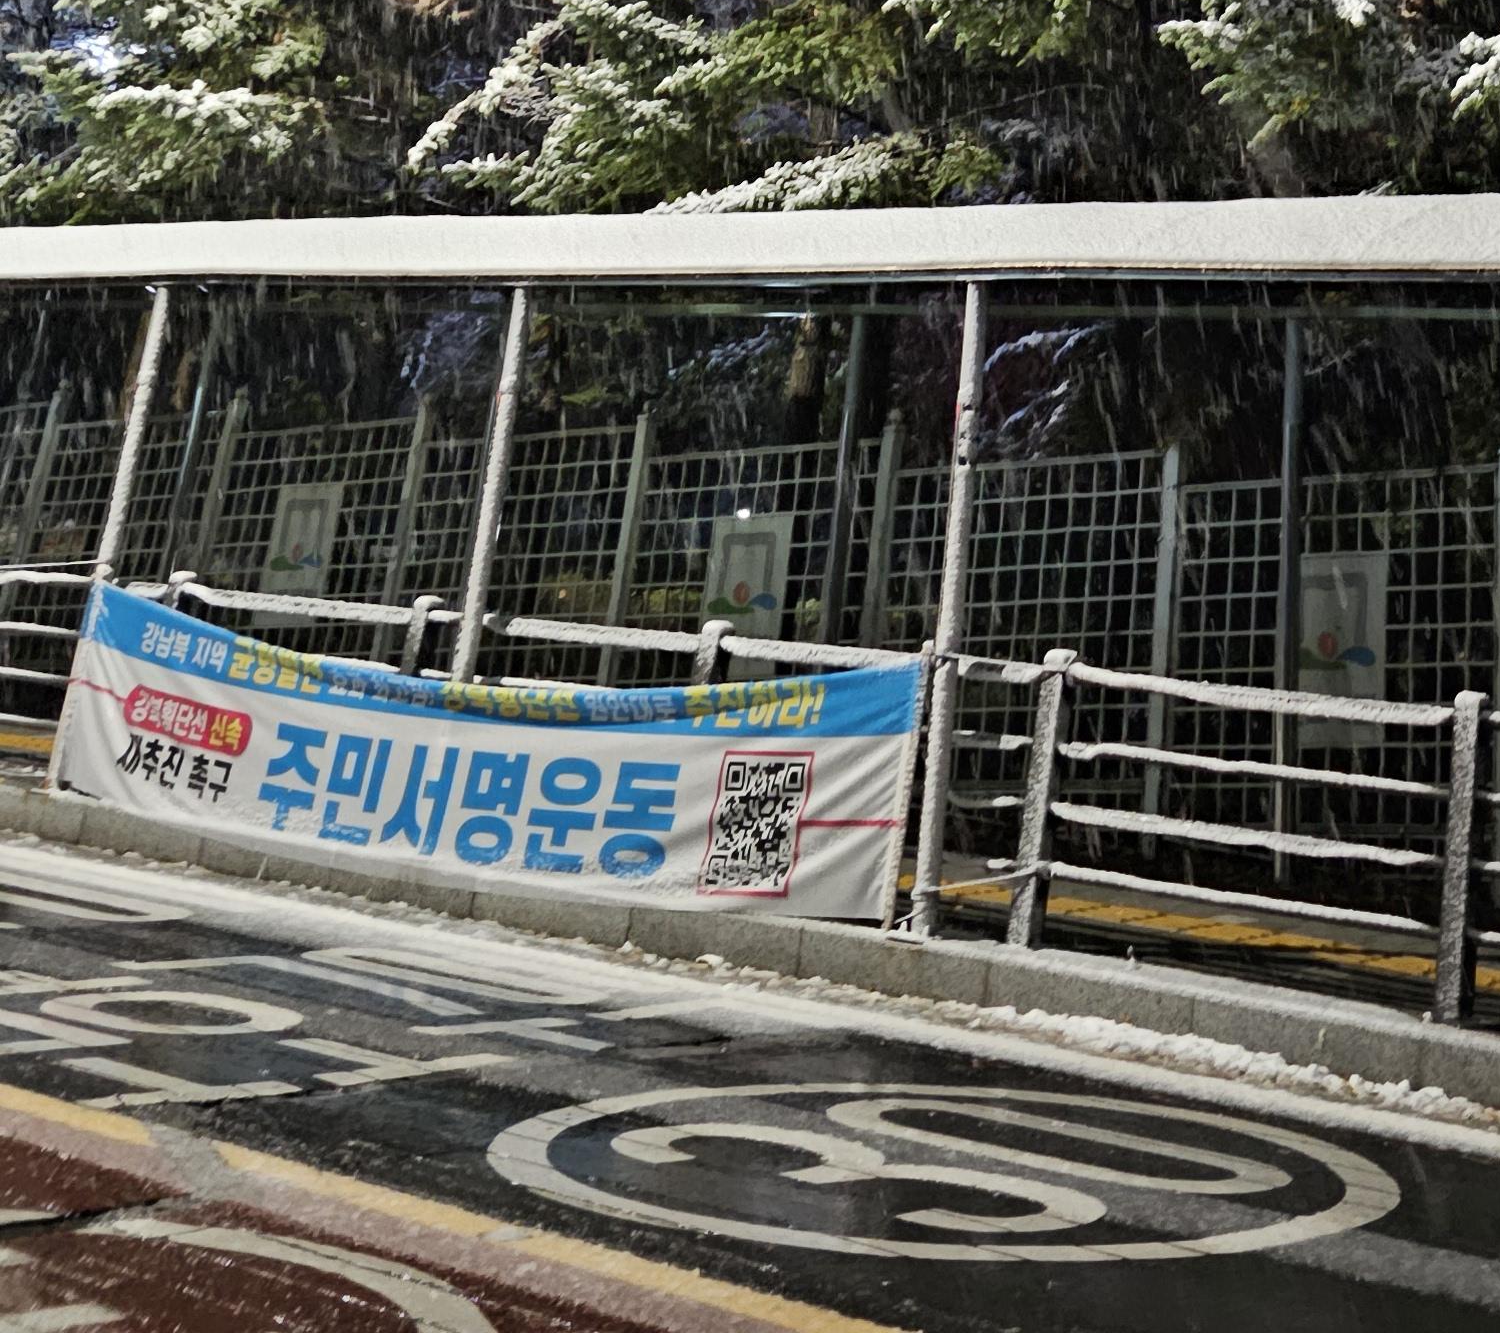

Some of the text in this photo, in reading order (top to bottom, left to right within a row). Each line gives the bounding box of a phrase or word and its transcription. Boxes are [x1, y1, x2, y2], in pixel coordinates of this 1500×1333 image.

[130, 689, 244, 751] 강북횡단선 신속
[141, 621, 191, 665] 강남북
[192, 636, 229, 673] 지역
[229, 634, 324, 694] 균형발전
[683, 678, 826, 729] 추진하라!
[115, 732, 233, 803] 재추진 촉구
[258, 722, 682, 878] 주민서명운동
[610, 1097, 1295, 1234] 30
